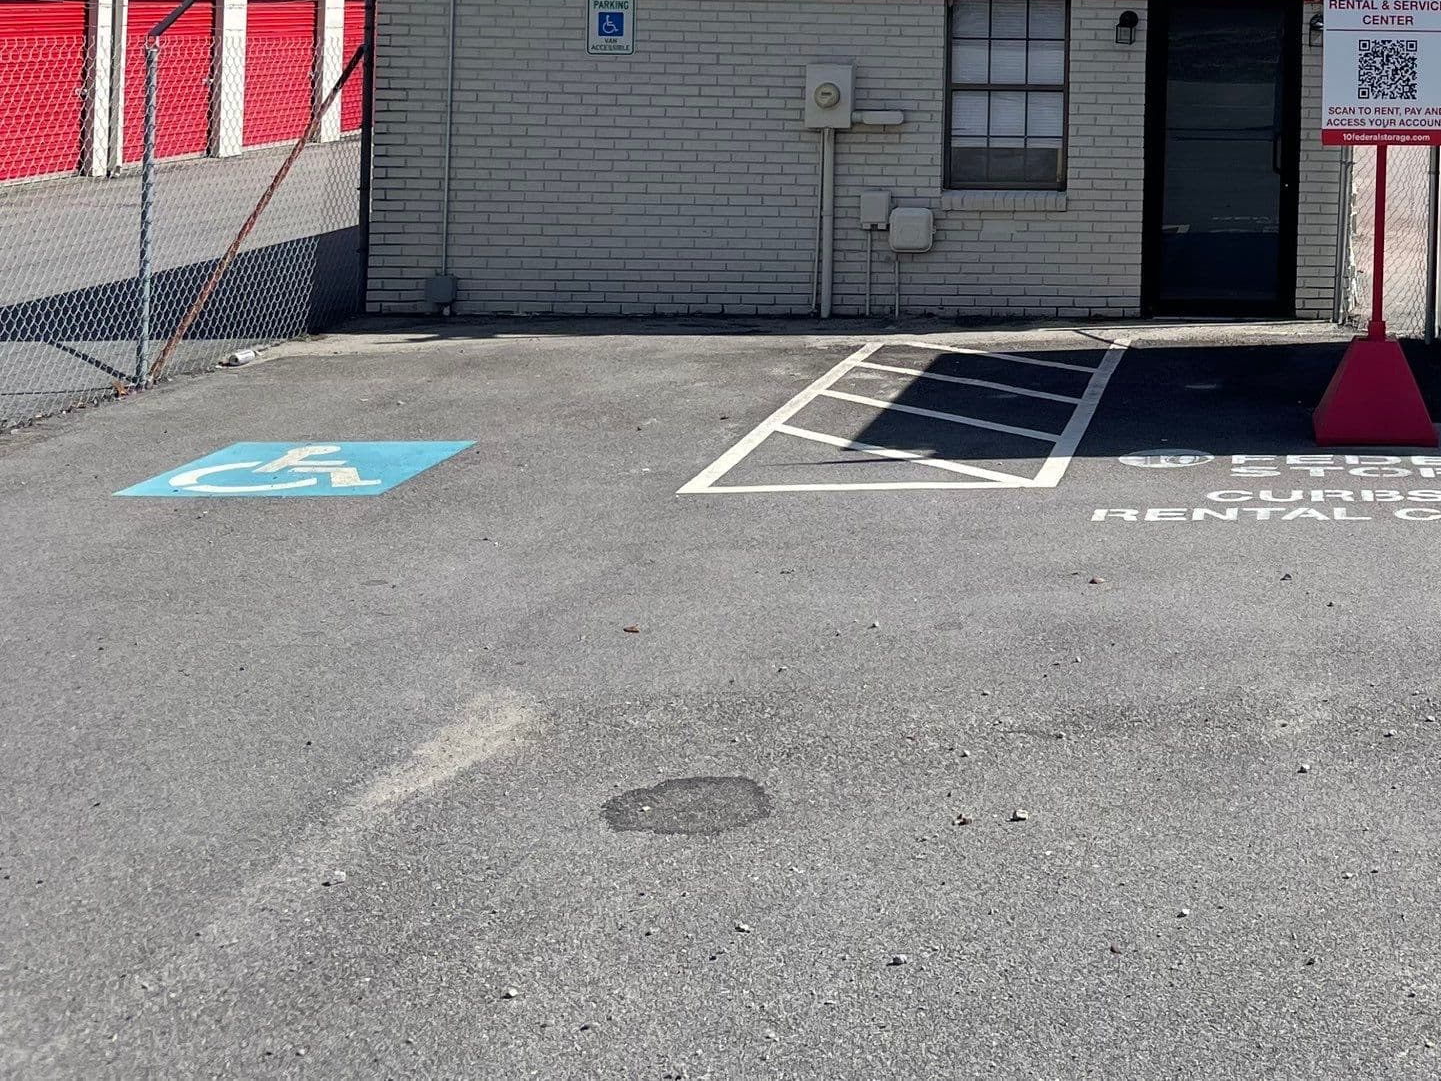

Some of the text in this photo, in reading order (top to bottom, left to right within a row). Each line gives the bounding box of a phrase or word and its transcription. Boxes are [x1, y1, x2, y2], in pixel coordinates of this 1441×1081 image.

[594, 0, 629, 10] PARKING
[1329, 0, 1378, 11] RENTAL
[1381, 0, 1390, 11] &
[1362, 14, 1414, 26] CENTER
[1328, 106, 1356, 115] SCAN
[1358, 106, 1372, 115] TO
[1374, 106, 1402, 117] RENT,
[1404, 106, 1422, 116] PAY
[1326, 118, 1366, 127] ACCESS
[1368, 118, 1397, 128] YOUR
[1342, 132, 1430, 143] 10federalstorage.com
[1090, 507, 1373, 523] RENTAL
